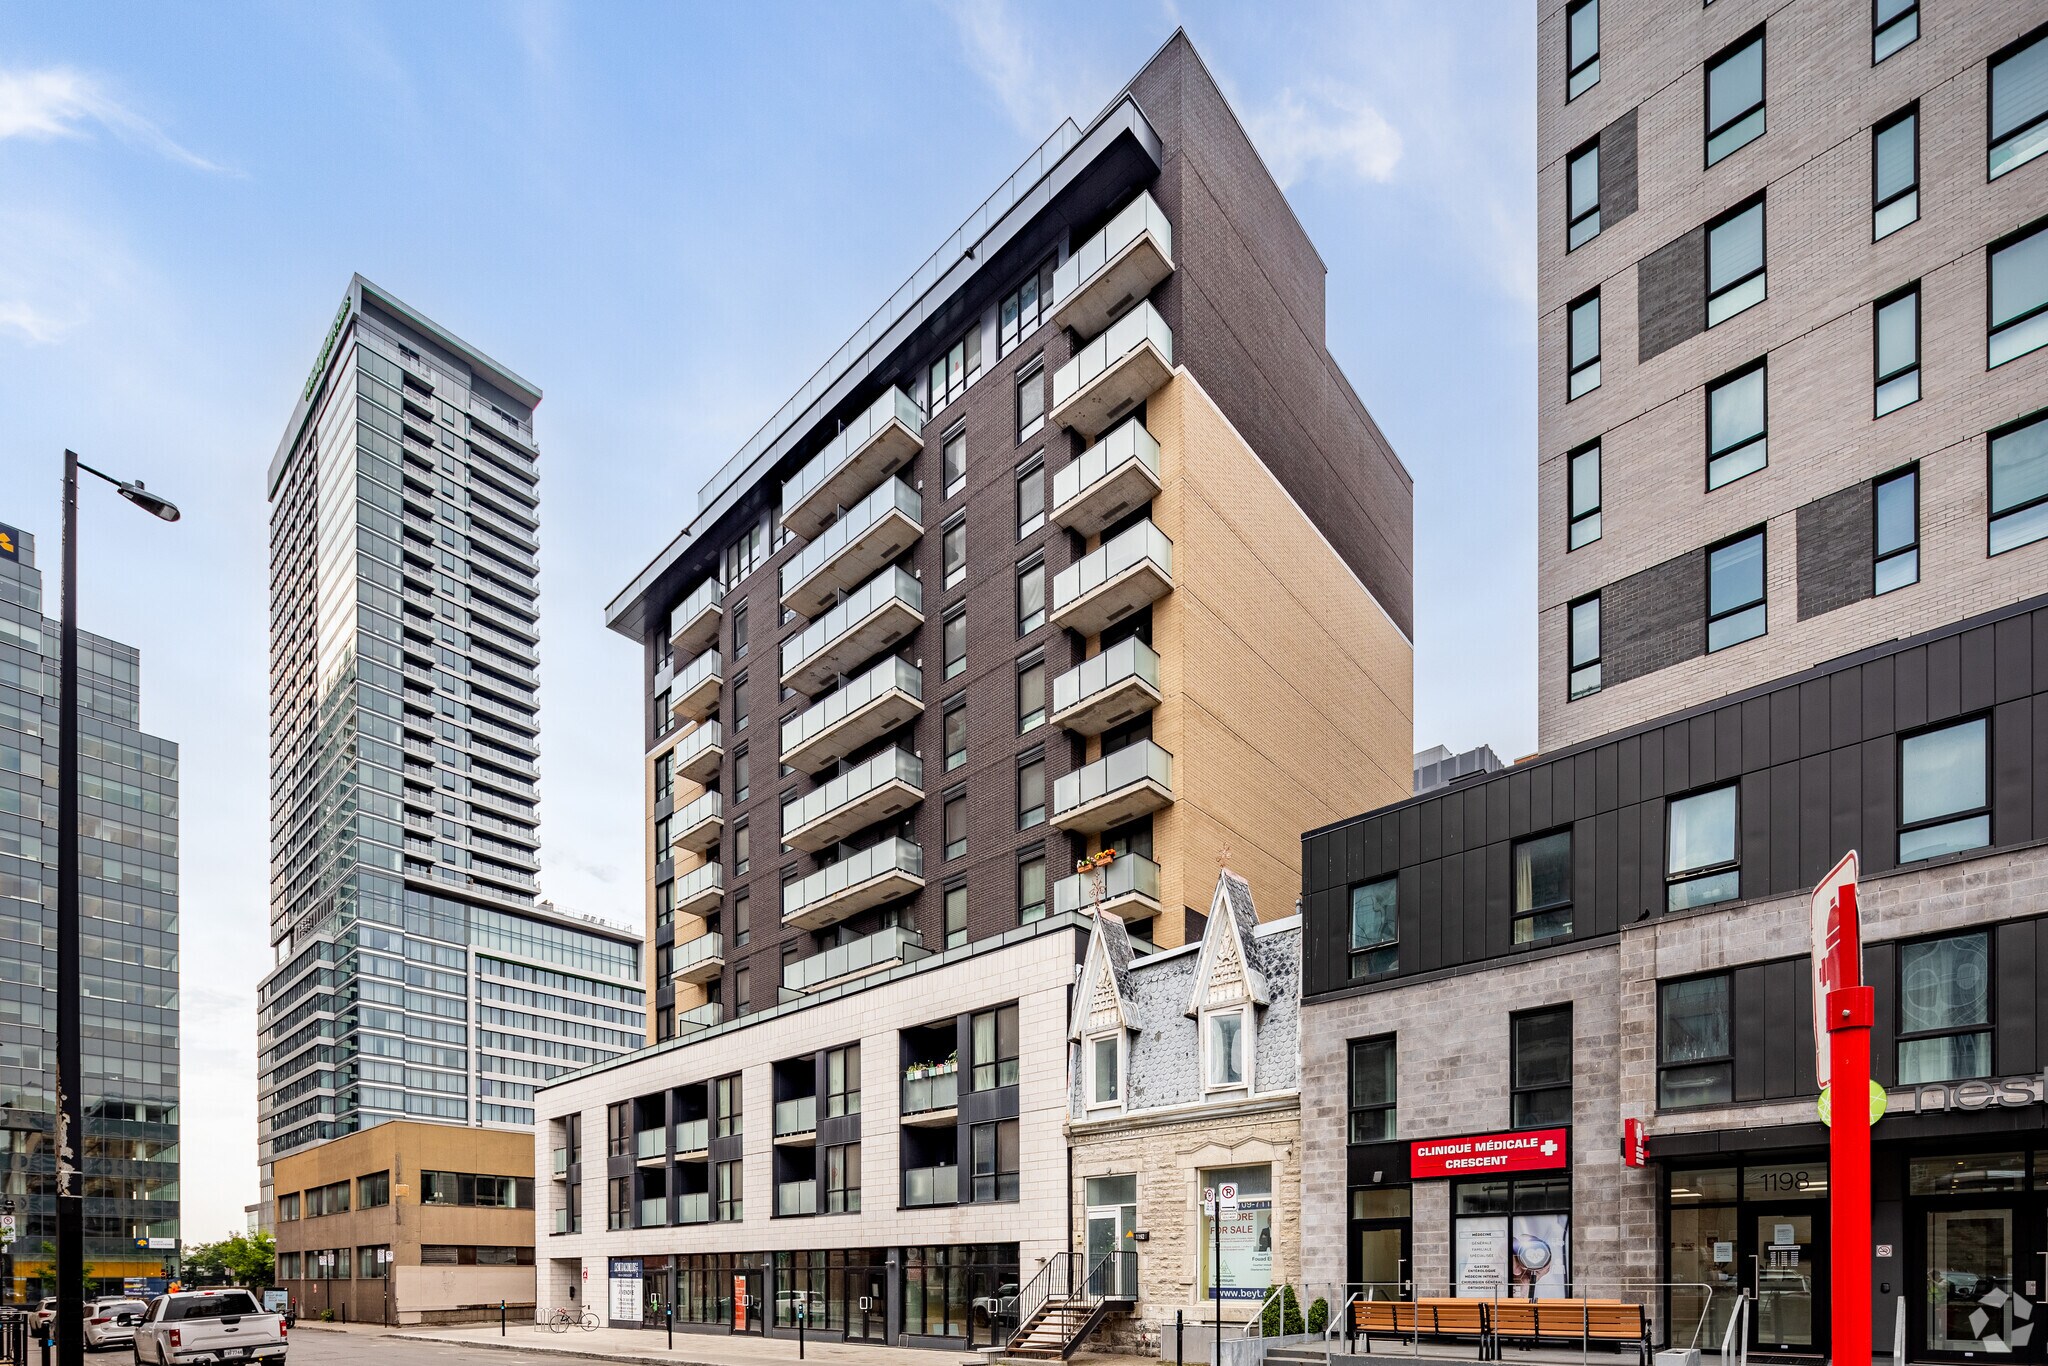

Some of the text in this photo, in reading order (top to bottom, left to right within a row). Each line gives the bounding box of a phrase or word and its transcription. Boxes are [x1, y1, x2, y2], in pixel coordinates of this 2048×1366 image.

[1417, 1137, 1538, 1157] CLINIQUE MÉDICALE
[1445, 1155, 1508, 1169] CRESCENT
[1760, 1171, 1810, 1192] 1198
[1230, 1225, 1253, 1234] SALE
